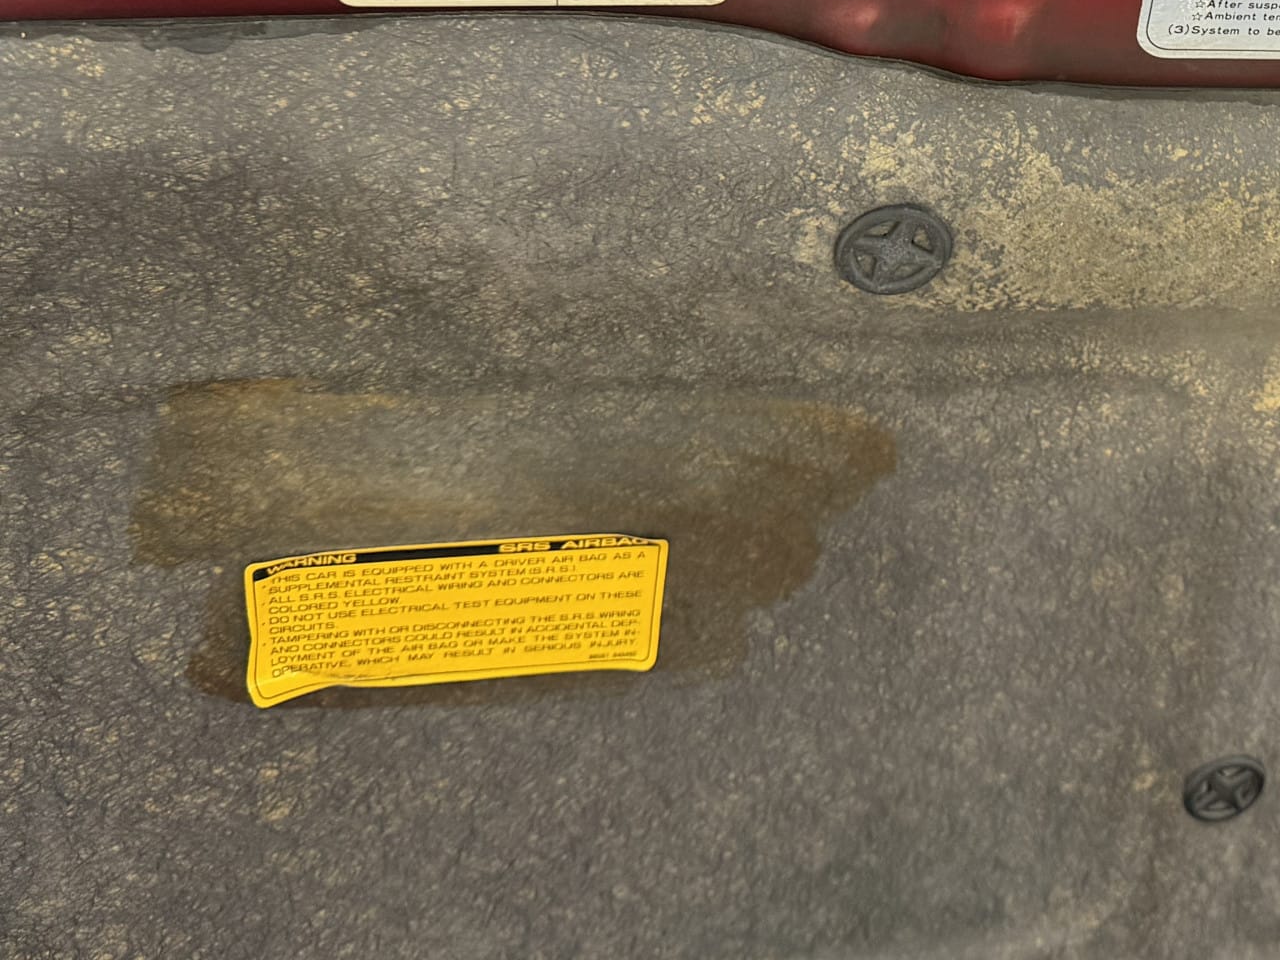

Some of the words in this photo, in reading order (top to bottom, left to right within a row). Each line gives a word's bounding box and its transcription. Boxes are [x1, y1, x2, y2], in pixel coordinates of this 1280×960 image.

[1247, 27, 1260, 36] to
[499, 542, 551, 553] SRS
[560, 537, 649, 550] AIRBAG
[266, 553, 357, 575] WARNING
[271, 573, 300, 584] THIS
[306, 572, 336, 581] CAR
[344, 570, 355, 578] IS
[362, 564, 433, 576] EQUIPPED
[440, 560, 473, 570] WITH
[494, 557, 546, 567] DRIVER
[552, 555, 573, 564] AIR
[579, 553, 607, 562] BAG
[637, 551, 646, 559] A
